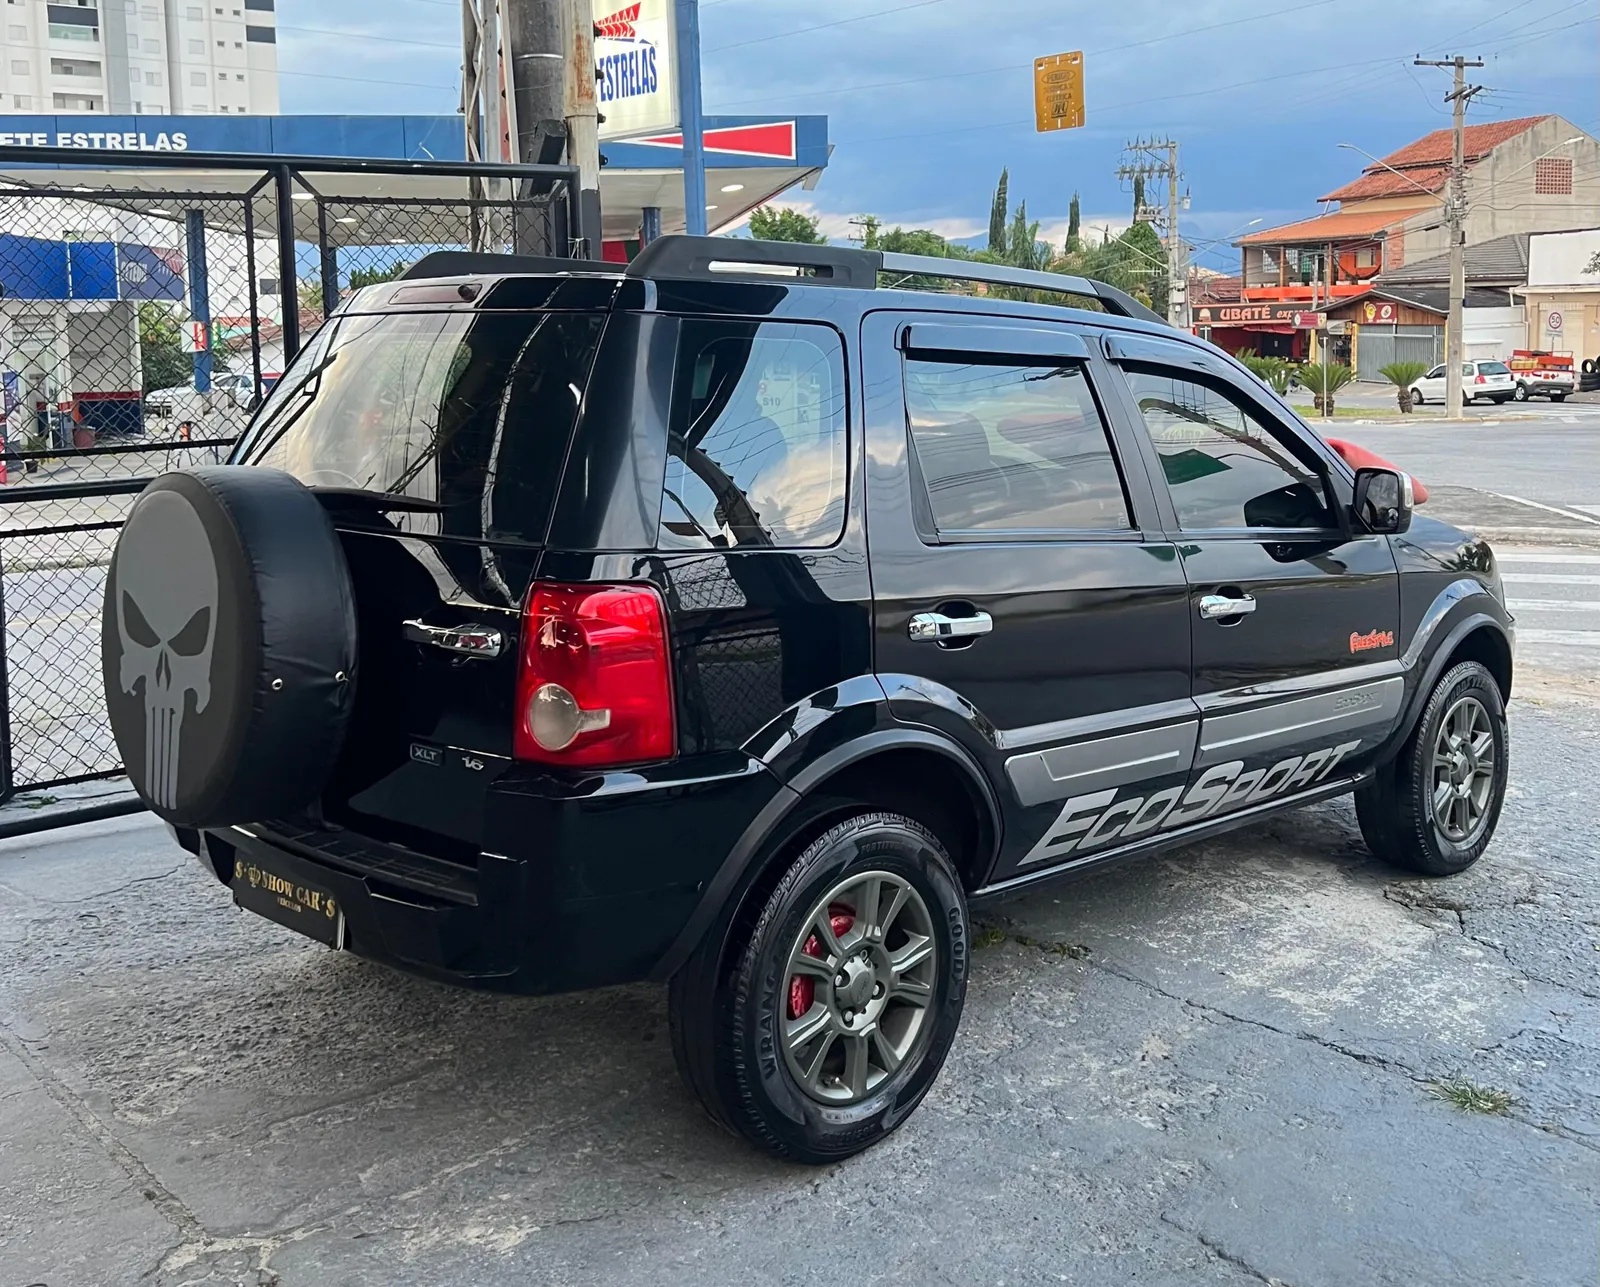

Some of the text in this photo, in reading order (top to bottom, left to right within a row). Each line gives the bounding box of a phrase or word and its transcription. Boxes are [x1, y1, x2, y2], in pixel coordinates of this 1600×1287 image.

[599, 46, 658, 102] ESTRELAS
[56, 132, 188, 151] ESTRELAS
[1220, 305, 1271, 320] UBATÉ
[763, 397, 781, 407] S10
[414, 746, 438, 761] XLT
[261, 869, 294, 898] SHOW
